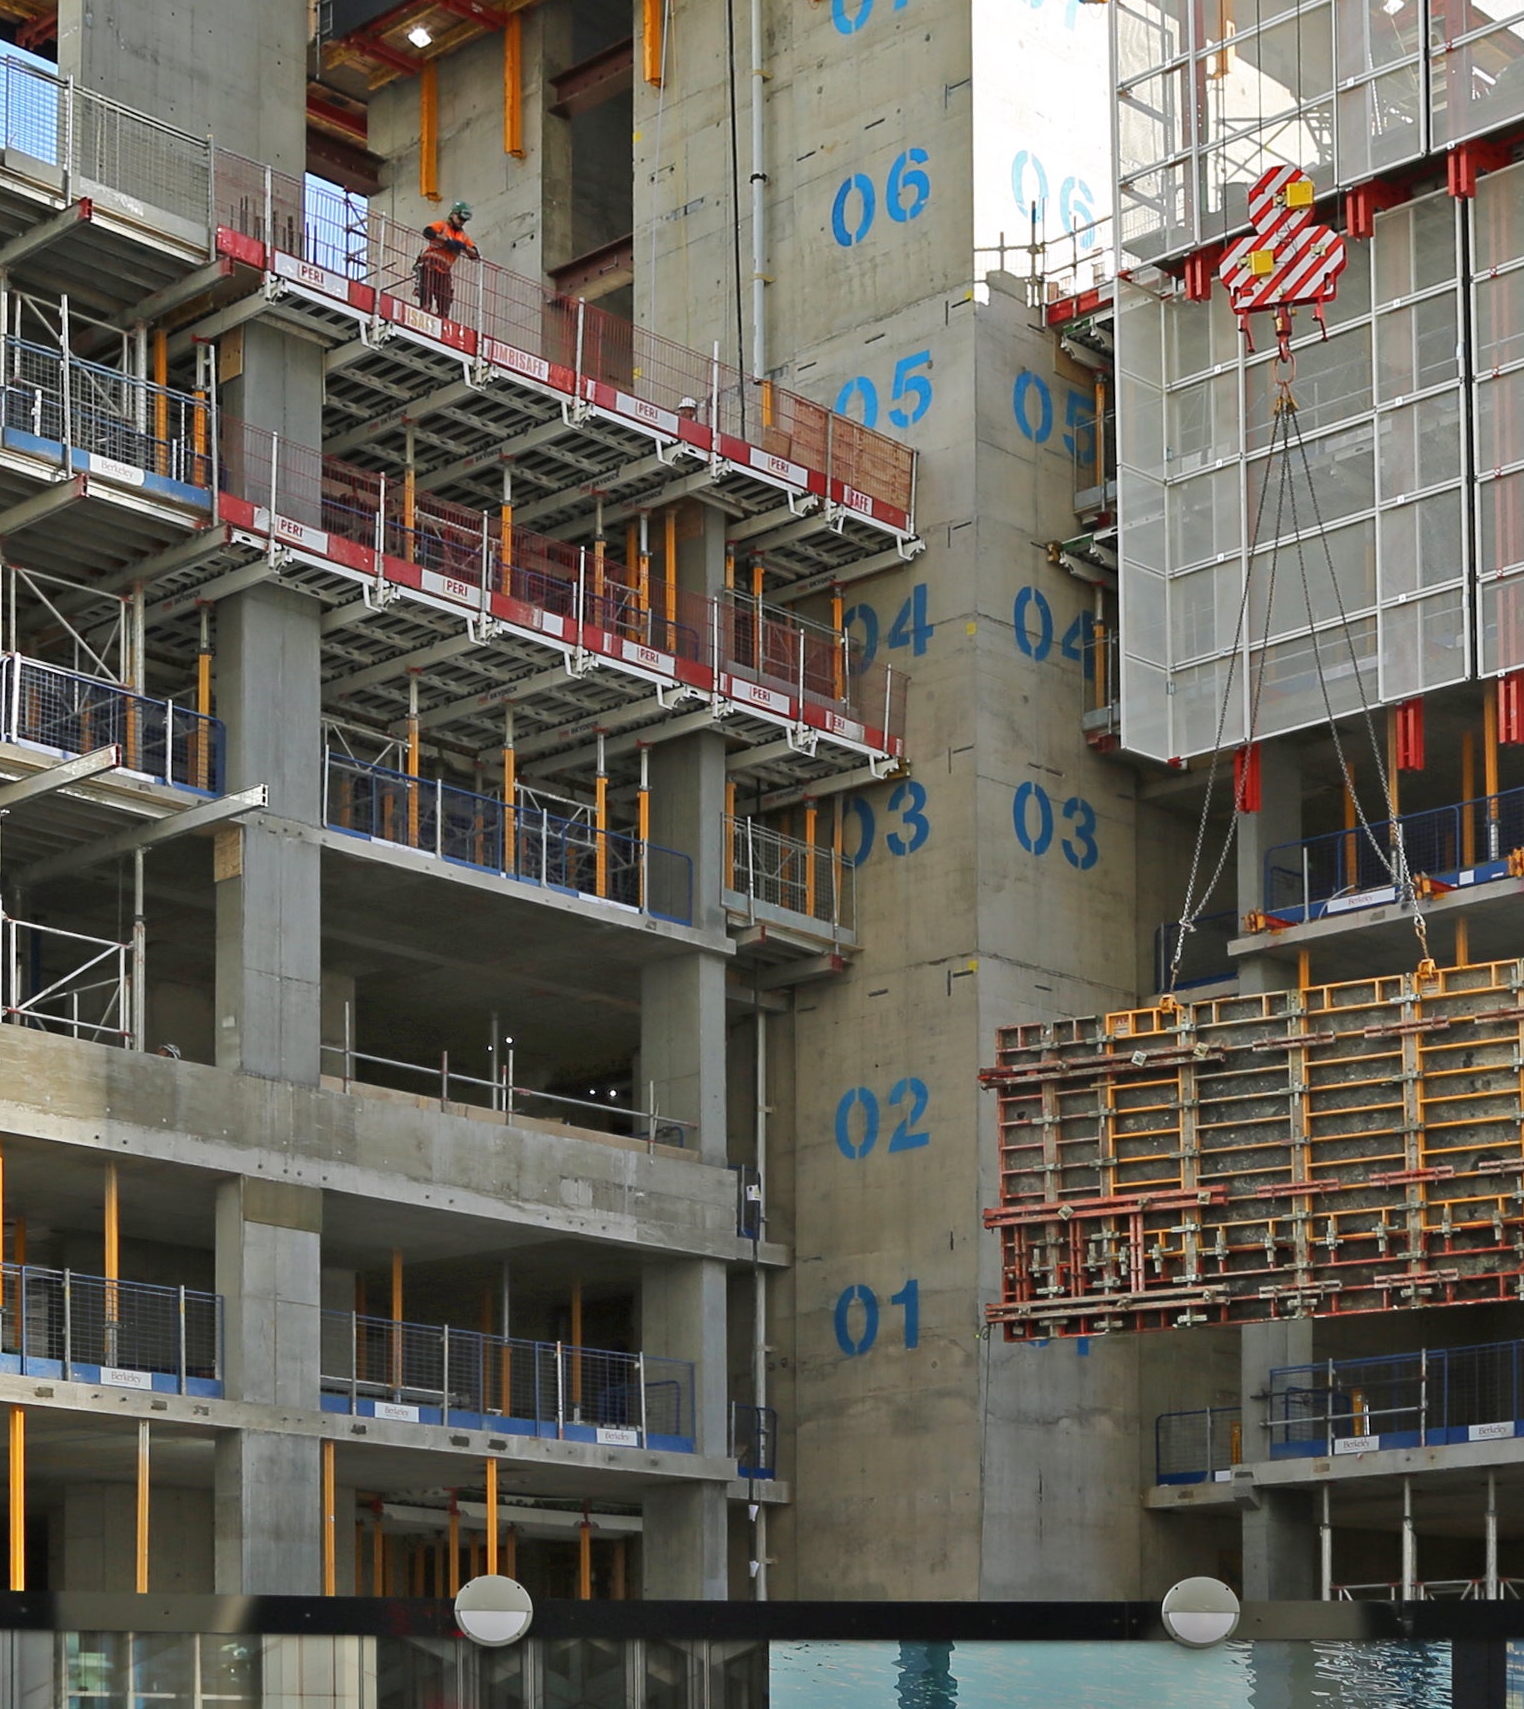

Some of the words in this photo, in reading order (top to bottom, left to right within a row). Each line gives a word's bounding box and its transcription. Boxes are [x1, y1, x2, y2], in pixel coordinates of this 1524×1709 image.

[831, 147, 931, 247] 06
[1011, 149, 1096, 249] 06
[300, 265, 325, 285] PERI
[637, 403, 659, 423] PERI
[835, 349, 934, 430] 05
[1013, 371, 1097, 465] 05
[101, 459, 134, 479] Berkeley
[770, 457, 790, 474] PERI
[280, 519, 303, 538] PERI
[446, 579, 468, 598] PERI
[844, 583, 933, 676] 04
[1014, 586, 1095, 681] 04
[640, 647, 659, 664] PERI
[752, 686, 771, 703] PERI
[841, 781, 930, 868] 03
[1013, 781, 1099, 870] 03
[835, 1077, 930, 1160] 02
[834, 1279, 919, 1356] 01
[1343, 1437, 1370, 1449] Berkeley
[1478, 1425, 1507, 1436] Berkeley
